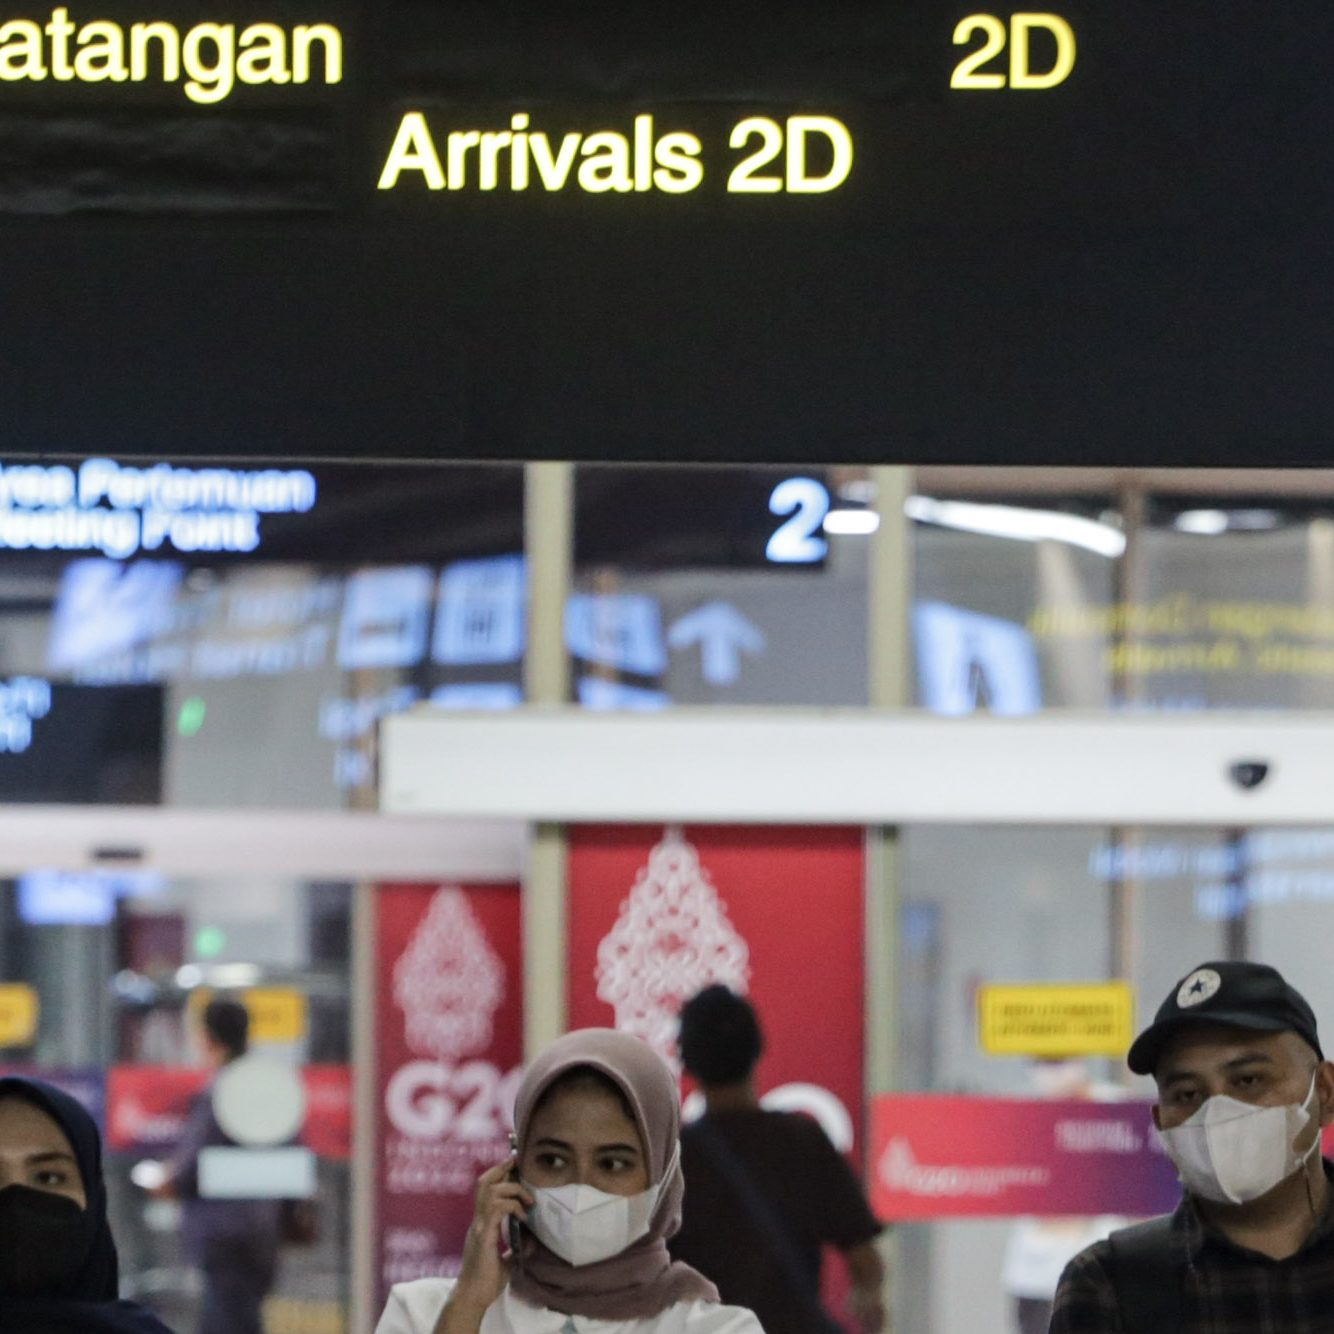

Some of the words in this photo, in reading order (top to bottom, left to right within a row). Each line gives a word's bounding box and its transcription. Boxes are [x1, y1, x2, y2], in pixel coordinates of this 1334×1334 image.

[950, 12, 1076, 90] 2D
[377, 111, 704, 193] Arrivals
[726, 116, 855, 193] 2D
